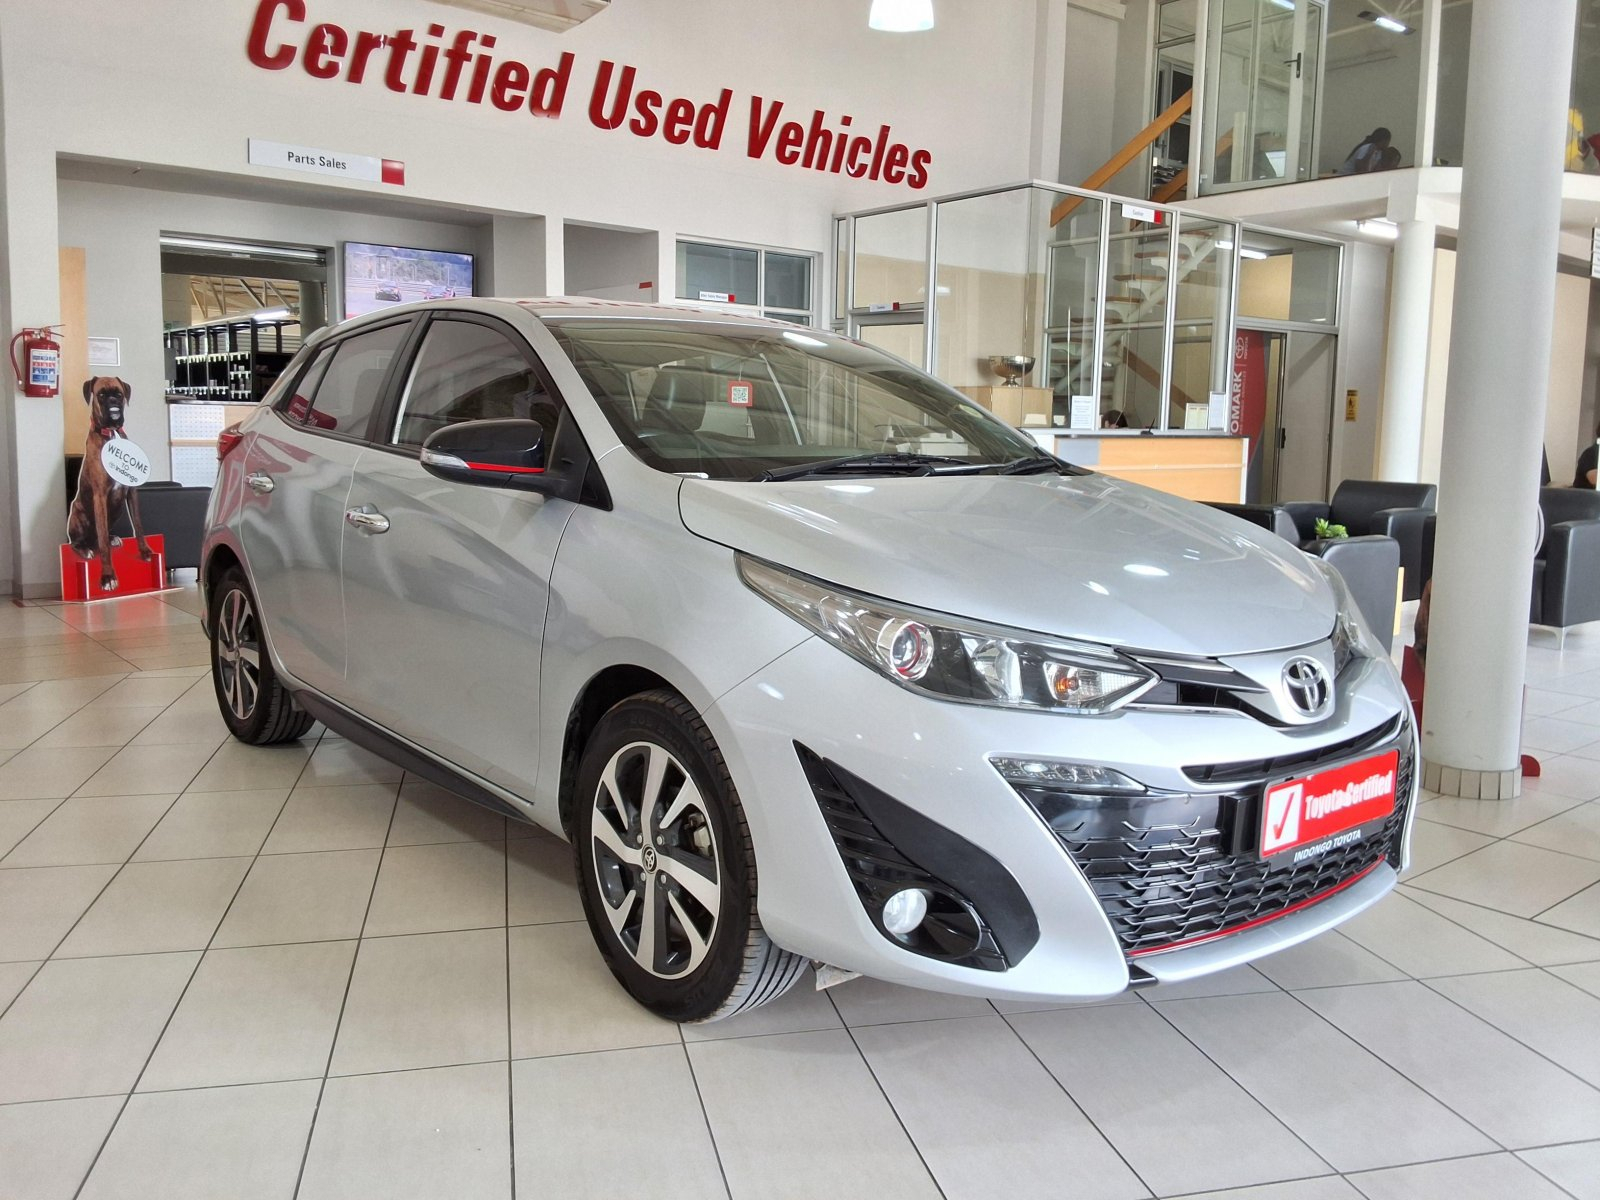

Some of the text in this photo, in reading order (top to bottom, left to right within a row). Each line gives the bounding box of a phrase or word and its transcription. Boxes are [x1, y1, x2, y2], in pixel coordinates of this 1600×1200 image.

[248, 0, 931, 189] Certified Used Vehicles
[287, 151, 347, 170] Parts Sales
[1230, 370, 1243, 434] OMARK
[108, 444, 148, 474] WELCOME
[121, 462, 130, 471] TO
[1294, 829, 1361, 862] INDONGO TOYOTA
